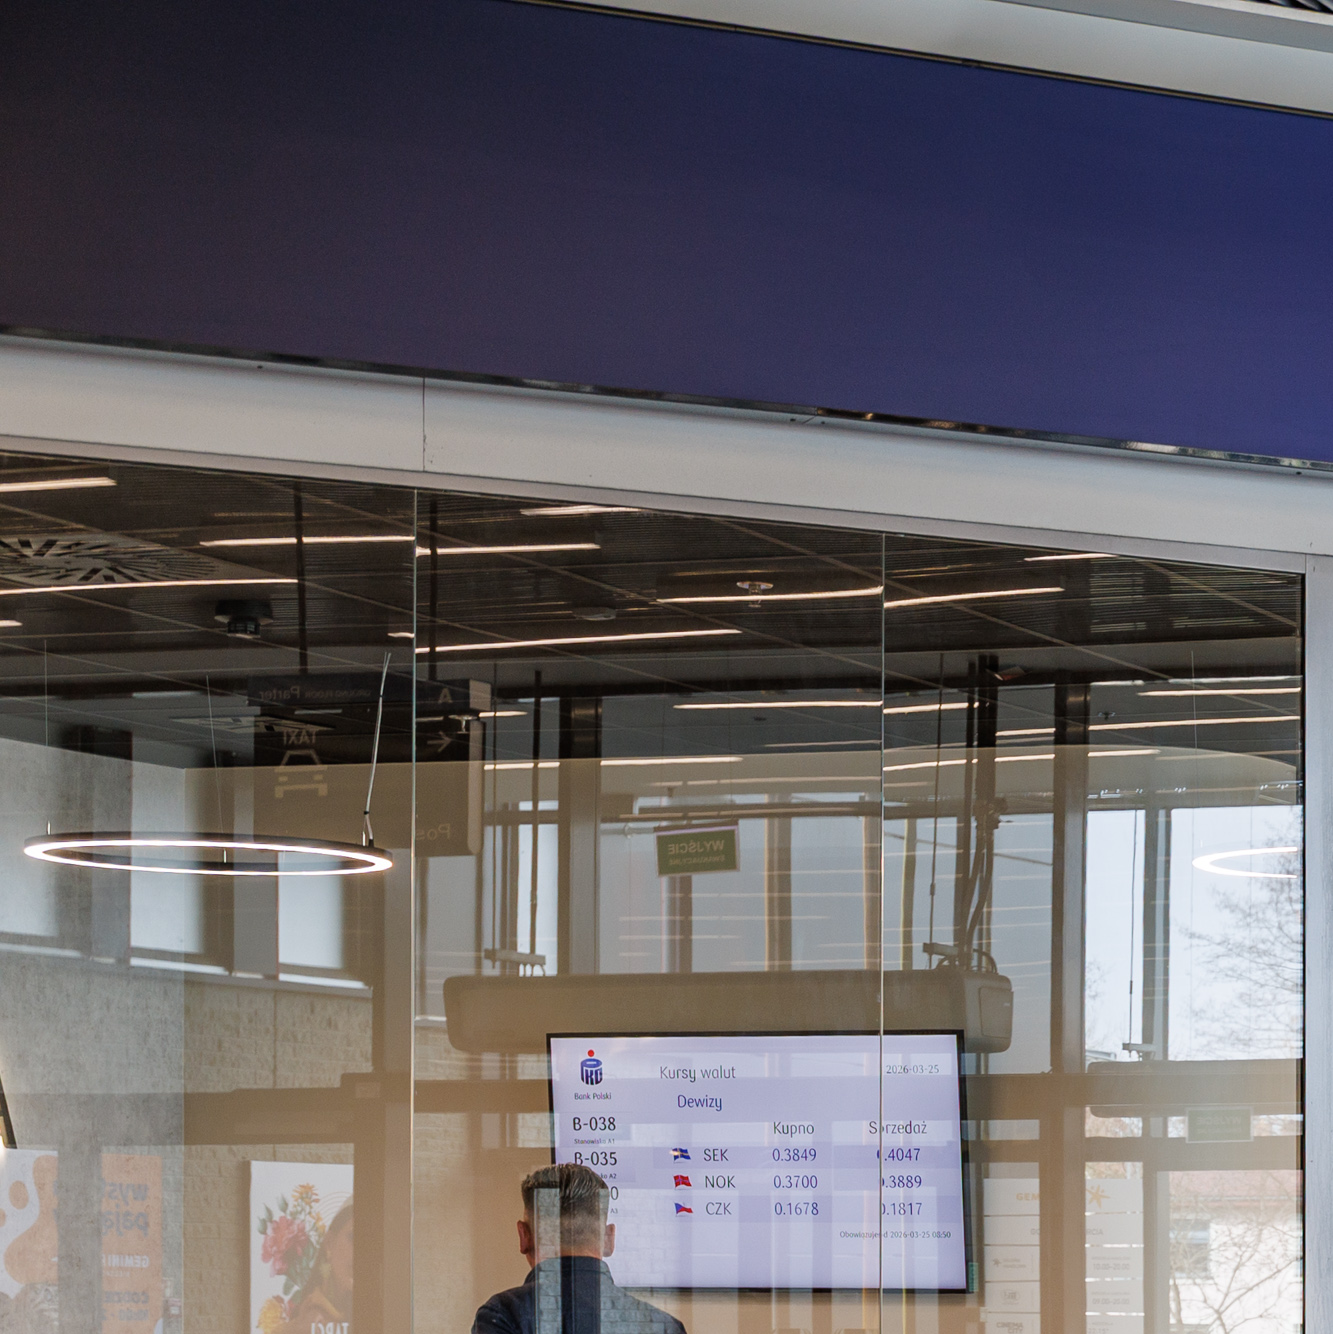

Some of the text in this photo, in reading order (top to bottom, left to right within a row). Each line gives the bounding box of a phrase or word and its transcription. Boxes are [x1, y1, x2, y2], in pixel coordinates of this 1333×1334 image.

[660, 1065, 736, 1083] Kursy walut
[886, 1064, 940, 1074] 2026-03-25
[574, 1092, 612, 1100] Bank Polski
[677, 1094, 723, 1112] Dewizy
[572, 1116, 616, 1131] B-038
[773, 1120, 928, 1138] Kupno Srzedaż
[574, 1151, 618, 1166] B-035
[703, 1148, 729, 1162] SEK
[772, 1148, 817, 1162] 0.3849
[704, 1175, 736, 1189] NOK
[773, 1175, 818, 1189] 0.3700
[705, 1202, 732, 1216] CZK
[774, 1201, 819, 1216] 0.1678
[890, 1231, 931, 1239] 2026-03-25
[931, 1231, 952, 1239] 08:50
